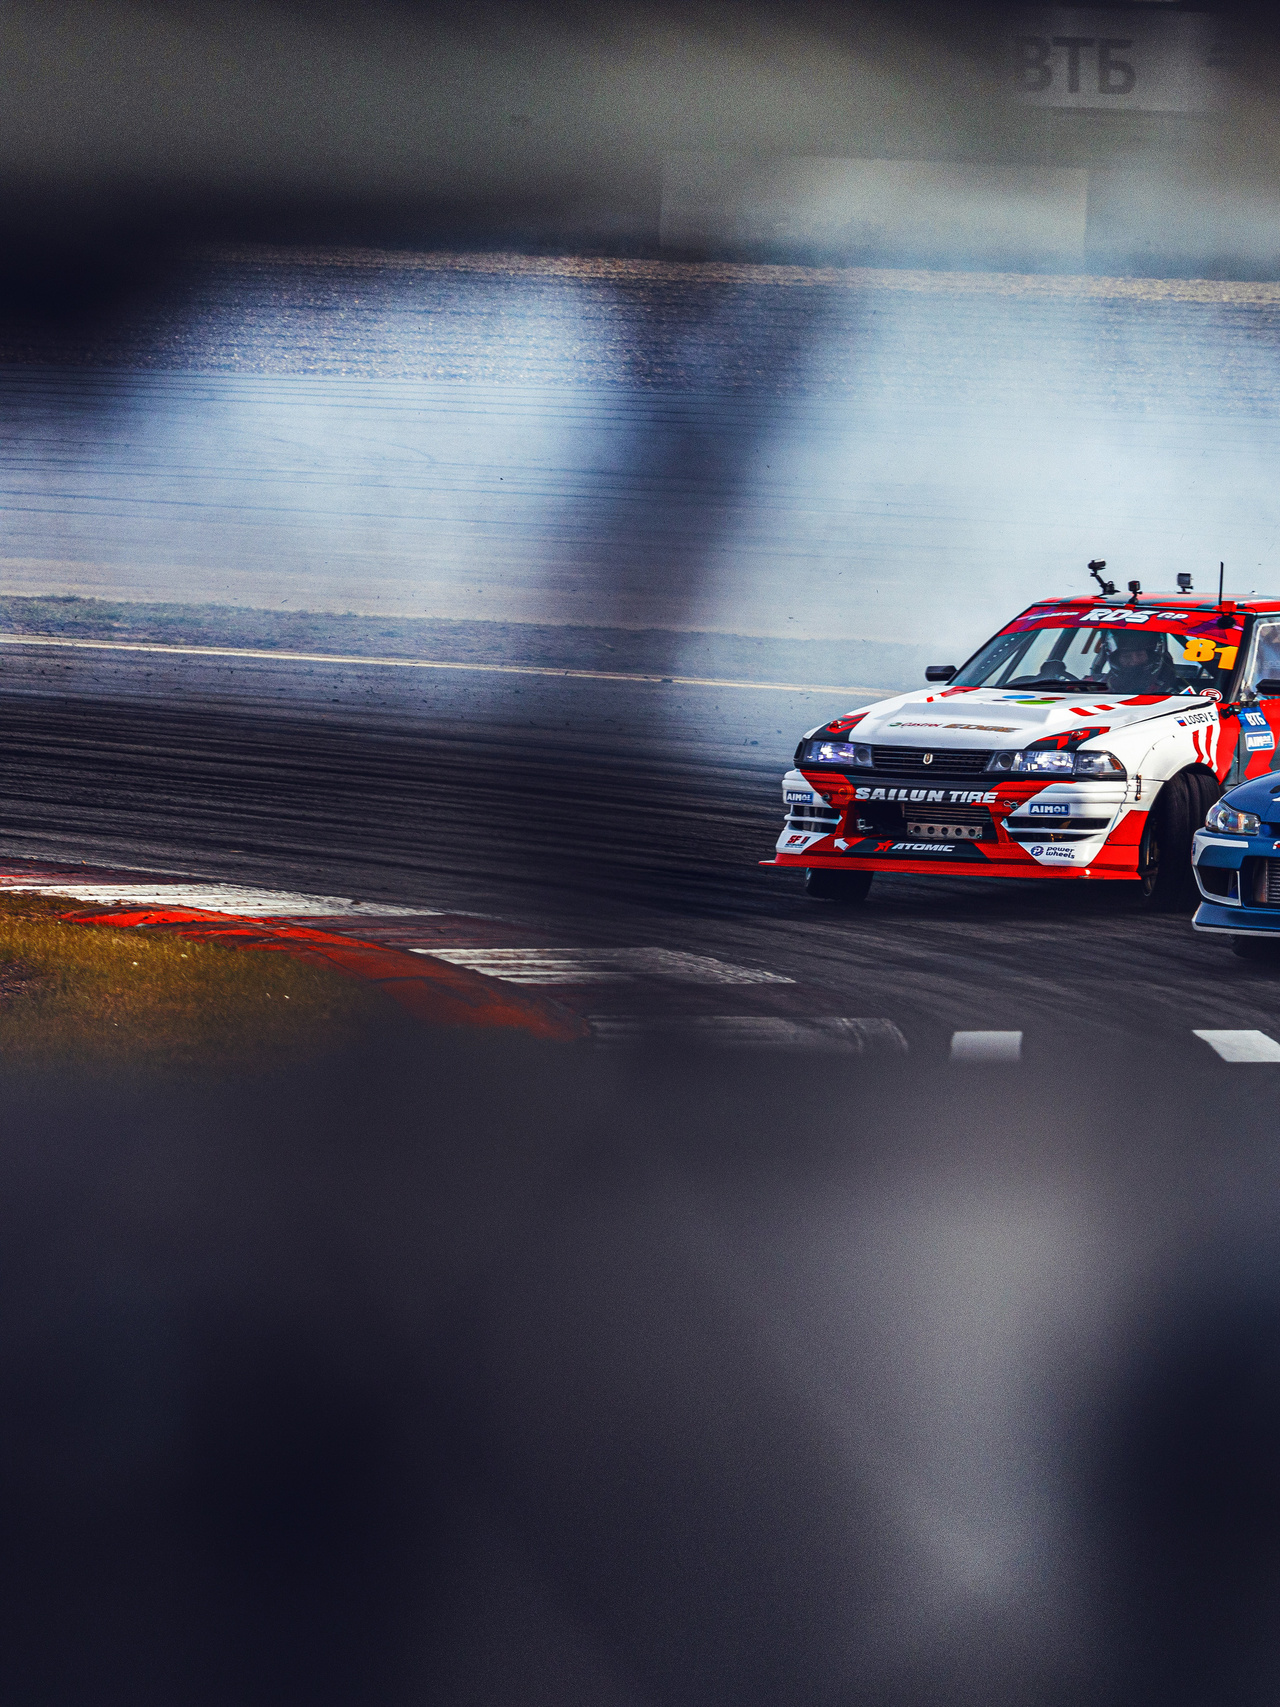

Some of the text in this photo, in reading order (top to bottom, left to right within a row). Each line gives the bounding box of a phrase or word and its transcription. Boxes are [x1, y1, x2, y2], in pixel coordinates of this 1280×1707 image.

[1019, 34, 1136, 96] ВТБ
[1079, 608, 1160, 624] RDS
[1156, 611, 1190, 621] GP
[1183, 638, 1239, 670] 81
[1184, 712, 1209, 725] LOSEV
[1244, 712, 1267, 726] ВТБ
[855, 787, 999, 804] SAILUN TIRE
[1031, 805, 1068, 814] AIMOL
[892, 842, 955, 852] ATOMIC
[1046, 851, 1075, 859] wheels
